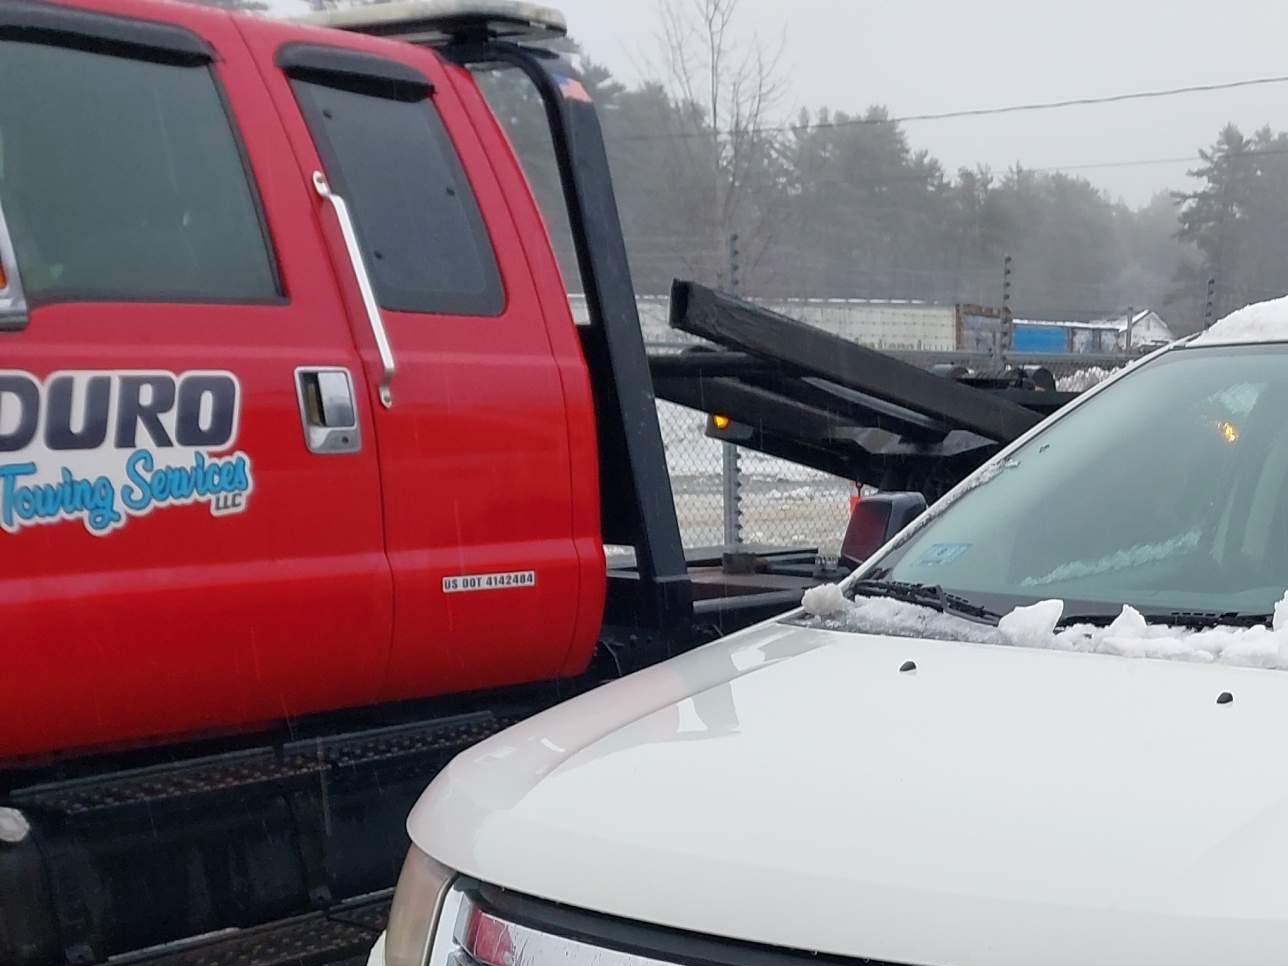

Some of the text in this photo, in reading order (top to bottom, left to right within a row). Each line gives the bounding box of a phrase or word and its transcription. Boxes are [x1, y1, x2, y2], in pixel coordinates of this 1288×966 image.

[0, 449, 248, 530] Towing Services
[215, 493, 242, 511] LLC
[444, 578, 458, 590] US
[462, 576, 482, 589] DOT
